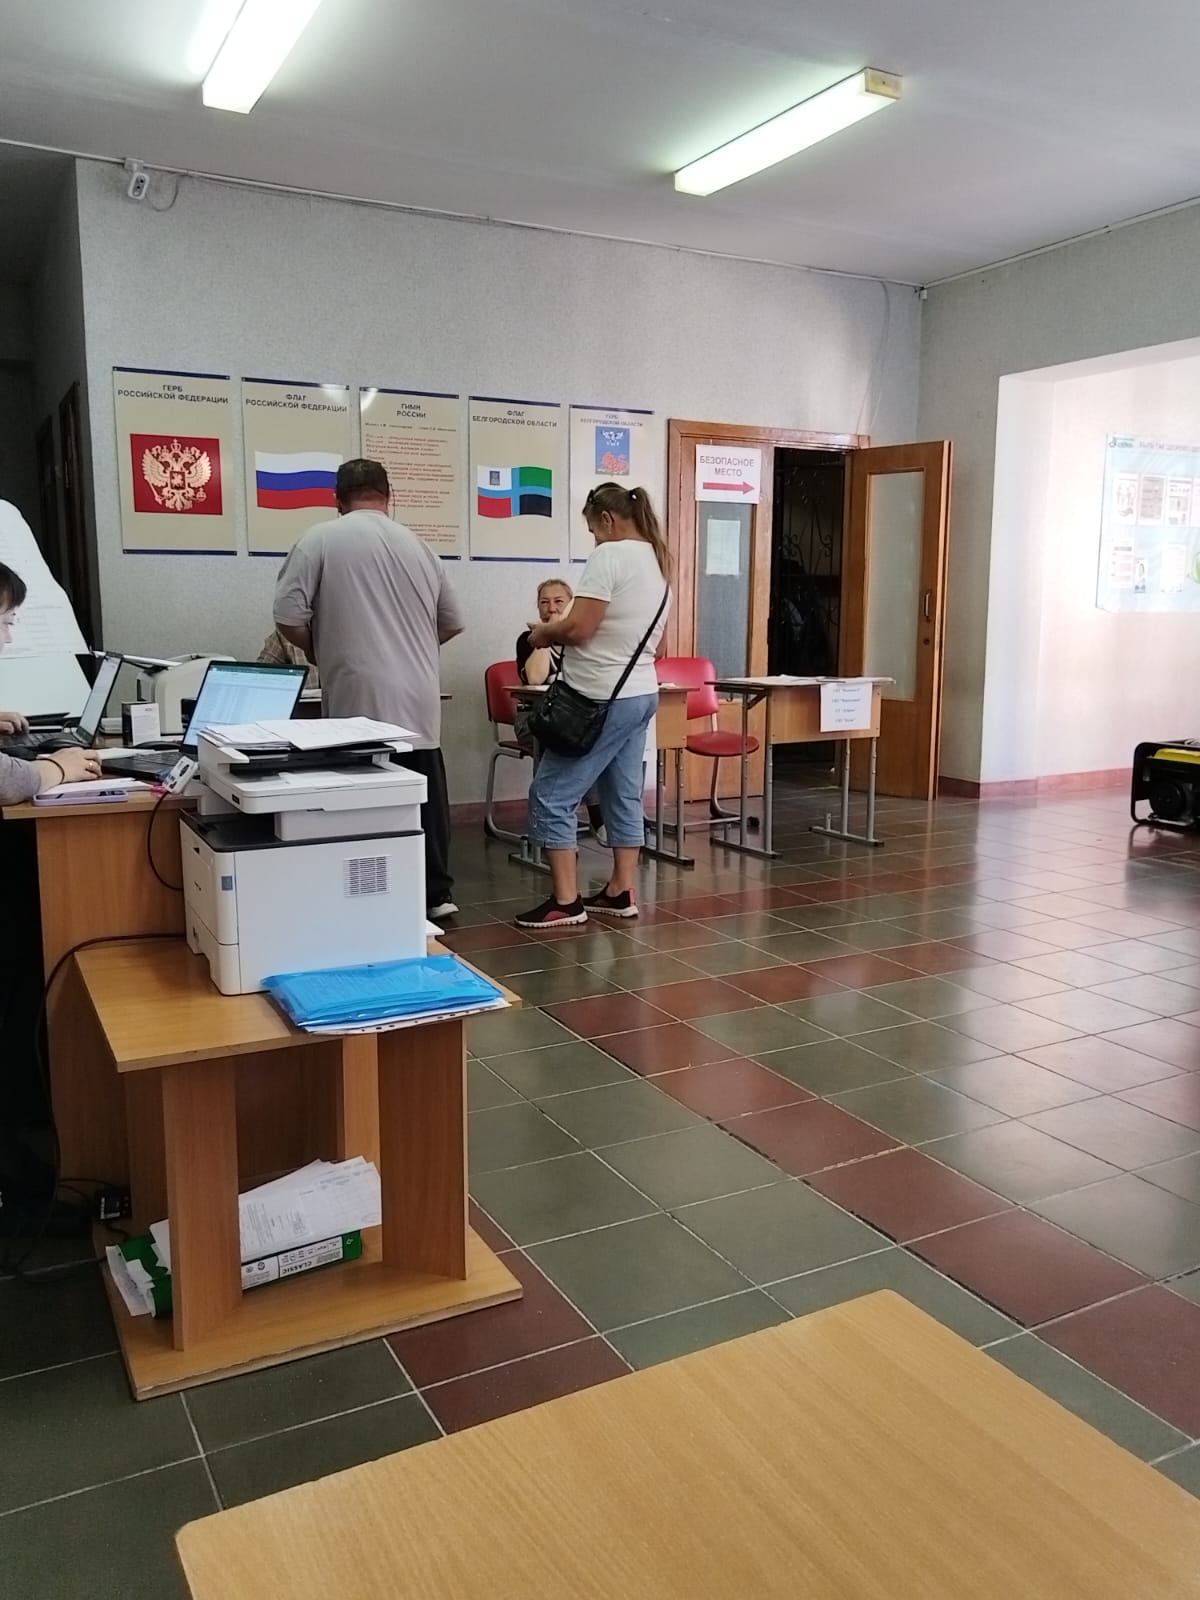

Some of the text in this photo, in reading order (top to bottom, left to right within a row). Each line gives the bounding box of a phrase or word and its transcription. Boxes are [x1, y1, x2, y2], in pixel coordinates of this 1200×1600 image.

[162, 384, 183, 392] ГЕРБ
[117, 389, 229, 404] РОССИЙСКОЙ ФЕДЕРАЦИИ
[286, 393, 307, 401] ФЛАГ
[245, 399, 347, 413] РОССИЙСКОЙ ФЕДЕРАЦИИ
[401, 403, 421, 411] ГИМН
[396, 410, 427, 419] РОССИИ
[472, 415, 557, 428] БЕЛГОРОДСКОЙ ОБЛАСТИ
[699, 456, 755, 467] БЕЗОПАСНОЕ
[714, 467, 743, 477] МЕСТО
[281, 1260, 313, 1275] CLASSIC
